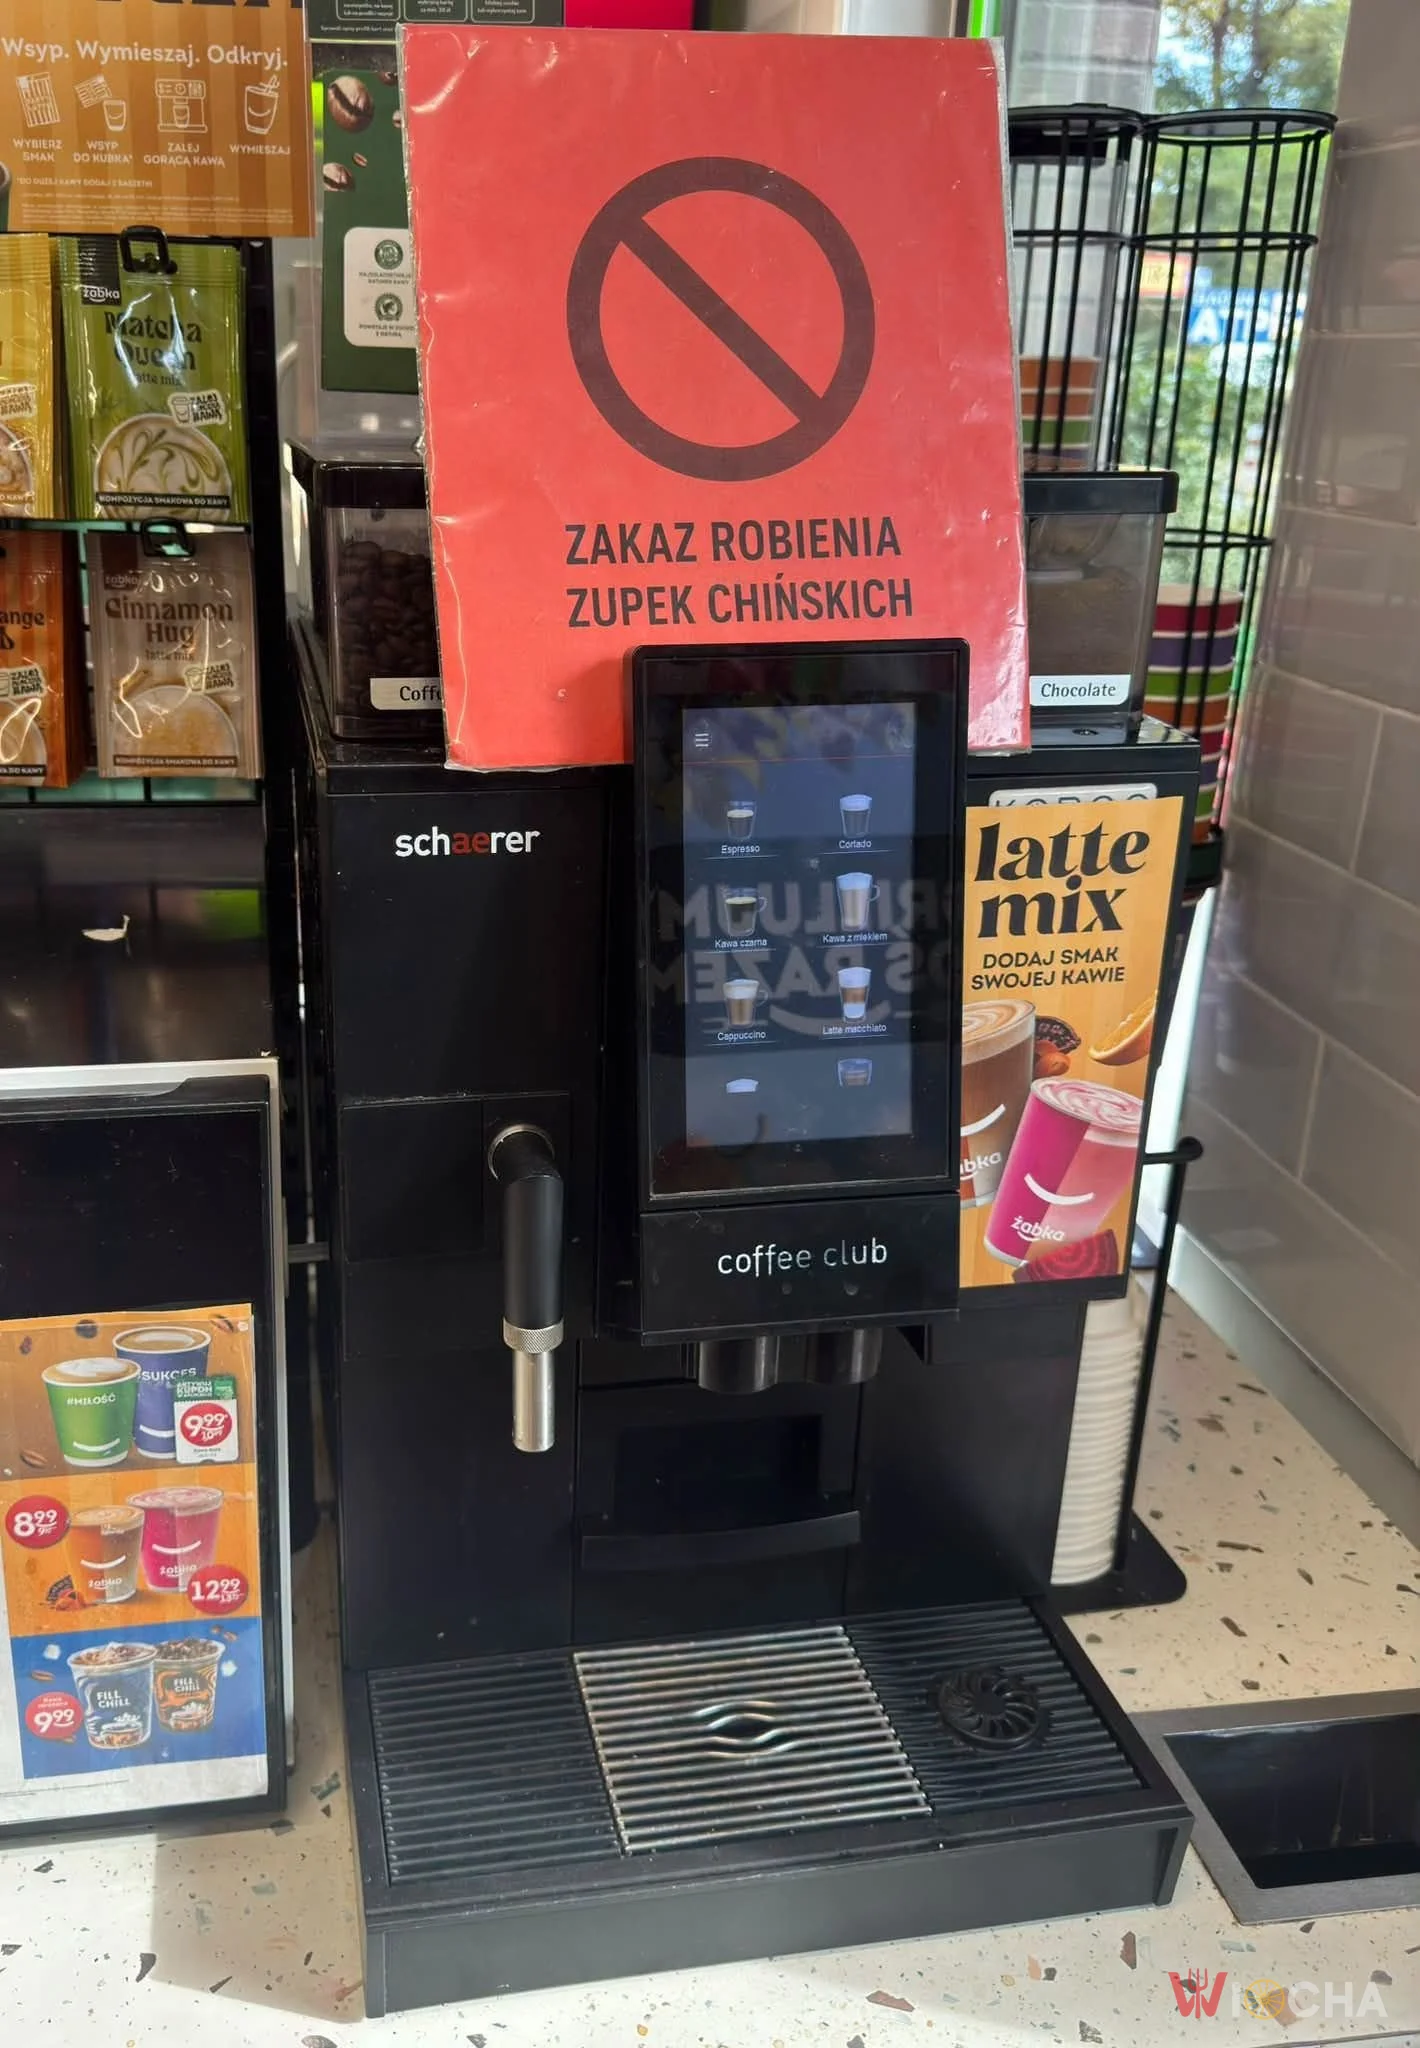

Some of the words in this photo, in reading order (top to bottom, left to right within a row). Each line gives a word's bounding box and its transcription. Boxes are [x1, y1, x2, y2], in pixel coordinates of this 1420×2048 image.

[1, 37, 70, 62] Wsyp.
[76, 40, 200, 68] Wymieszaj.
[207, 44, 288, 70] Odkryj.
[13, 138, 63, 151] WYBIERZ
[87, 141, 119, 151] WSYP
[167, 142, 200, 153] ZALEJ
[229, 143, 291, 155] WYMIESZAJ
[23, 152, 54, 162] SMAK
[73, 153, 90, 163] DO
[193, 156, 226, 168] KAWĄ
[104, 311, 202, 343] Matcha
[565, 522, 697, 564] ZAKAZ
[711, 517, 901, 561] ROBIENIA
[566, 585, 696, 627] ZUPEK
[708, 573, 912, 623] CHIŃSKICH
[105, 596, 234, 621] Cinnamon
[145, 622, 195, 649] Hug
[1041, 683, 1116, 698] Chocolate
[395, 826, 540, 857] schaerer
[721, 844, 761, 856] Espresso
[839, 839, 872, 849] Cortado
[974, 820, 1150, 881] latte
[977, 874, 1127, 938] mix
[715, 939, 738, 949] Kawa
[740, 938, 768, 948] czarna
[823, 934, 845, 944] Kawa
[983, 949, 1055, 969] DODAJ
[1060, 946, 1120, 964] SMAK
[971, 973, 1056, 991] SWOJEJ
[1061, 966, 1126, 985] KAWIE
[717, 1031, 767, 1043] Cappuccino
[823, 1025, 843, 1035] Latte
[845, 1024, 887, 1034] macchiato
[960, 1150, 1002, 1176] bka
[1010, 1215, 1066, 1243] żabka
[717, 1244, 813, 1278] coffee
[823, 1236, 888, 1267] club
[141, 1367, 197, 1381] SUKCES
[97, 1689, 122, 1701] FILL
[98, 1698, 131, 1709] CHILL
